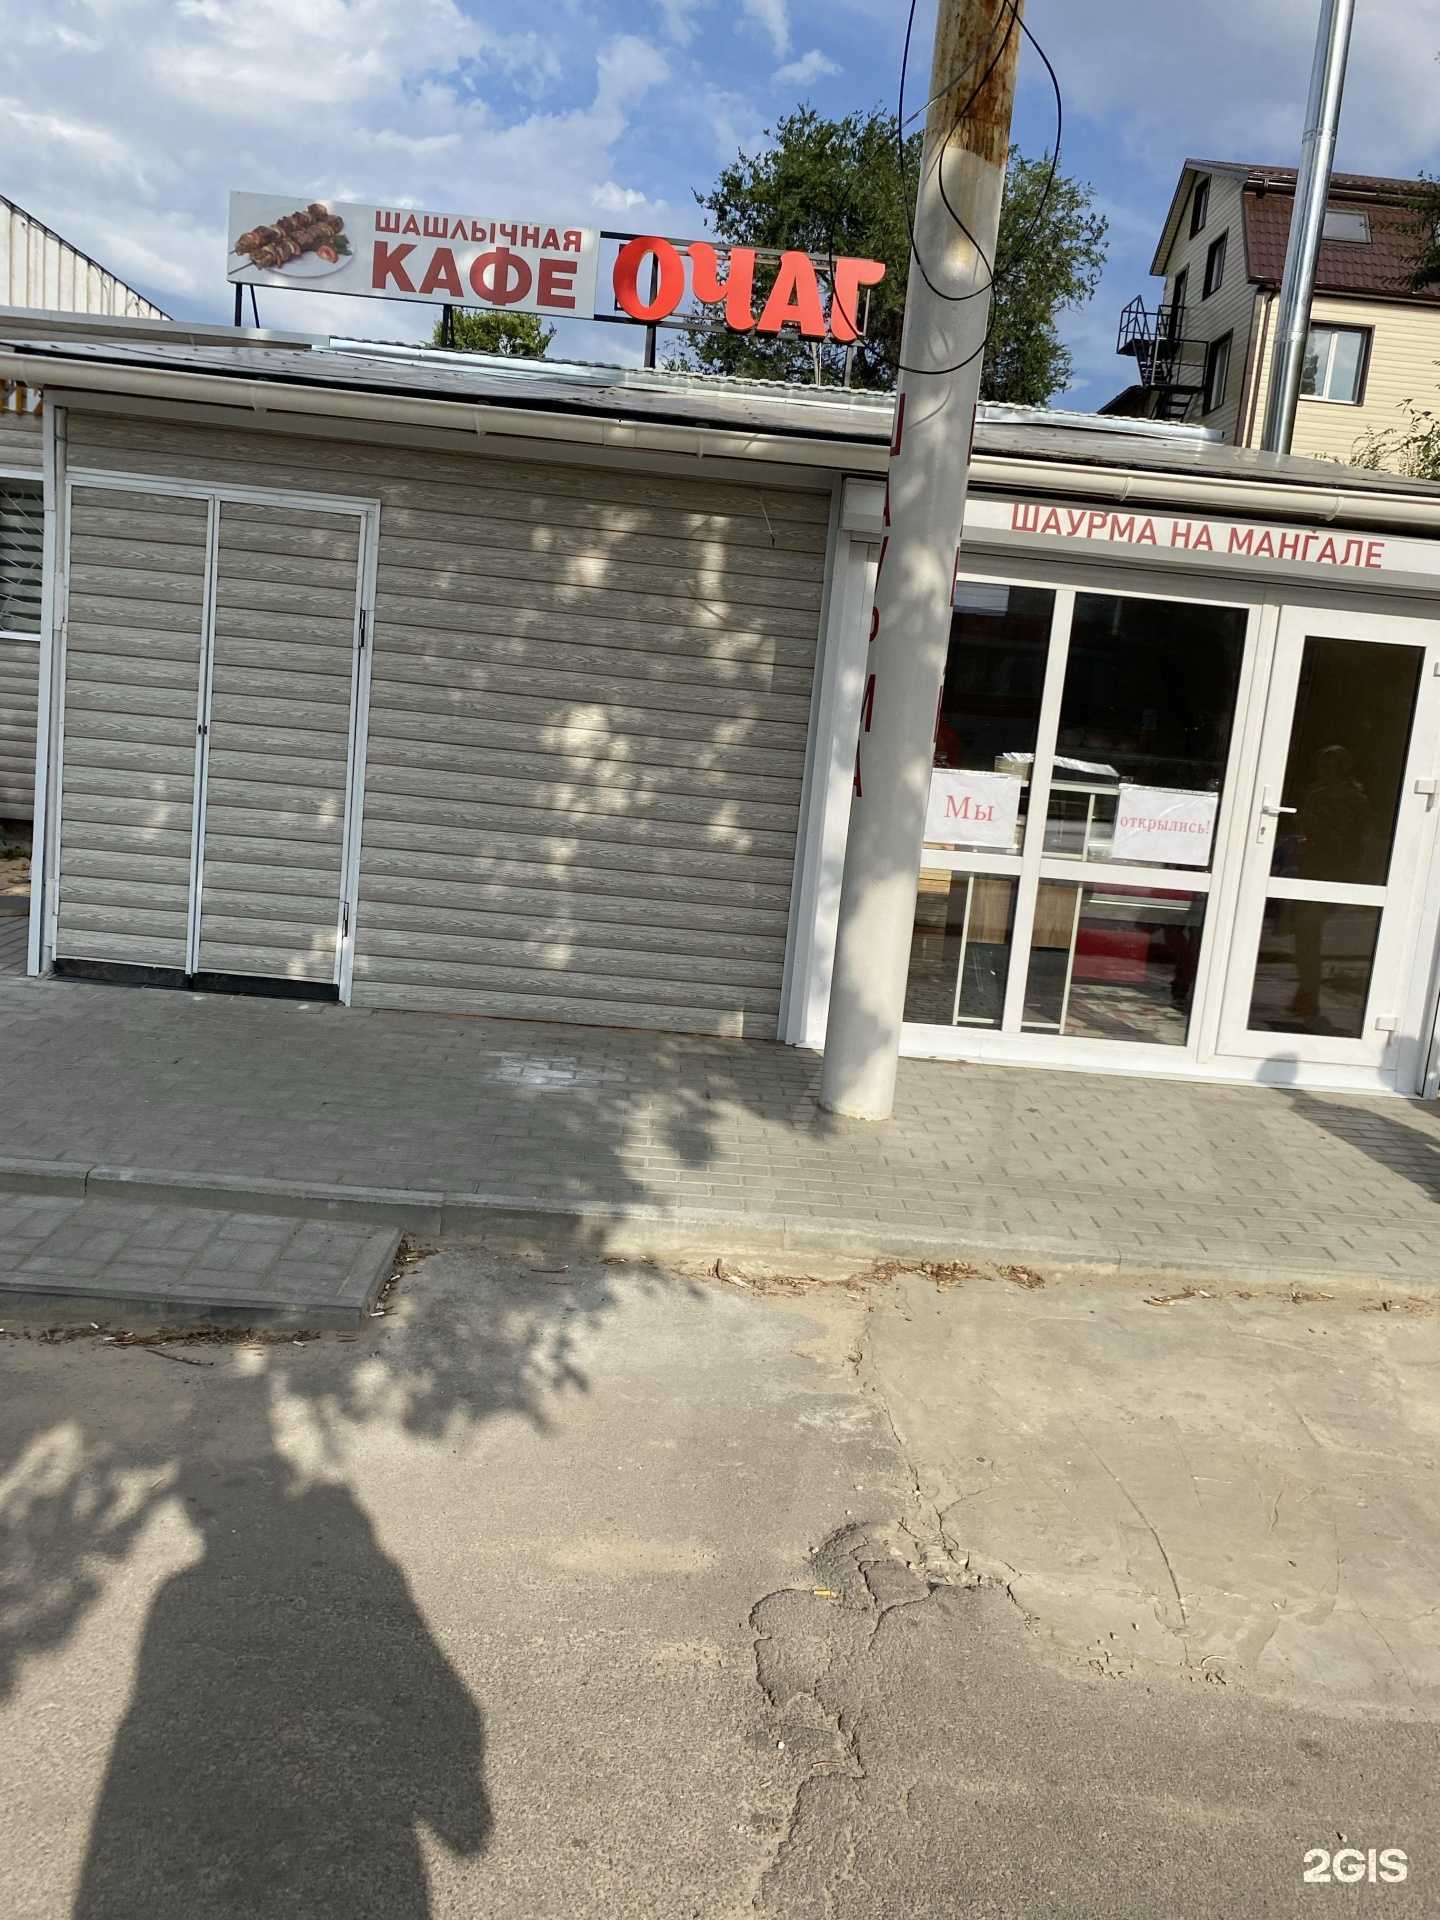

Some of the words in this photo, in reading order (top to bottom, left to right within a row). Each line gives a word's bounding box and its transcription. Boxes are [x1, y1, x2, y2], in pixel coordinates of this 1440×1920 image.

[375, 210, 582, 253] ШАШЛЫЧНАЯ
[371, 240, 578, 310] КАФЕ
[612, 236, 886, 342] ОЧАГ
[1011, 503, 1158, 546] ШАУРМА
[1170, 520, 1214, 551] НА
[1227, 527, 1386, 569] МАНГАЛЕ
[943, 795, 995, 823] Мы
[1119, 813, 1211, 835] открылись!
